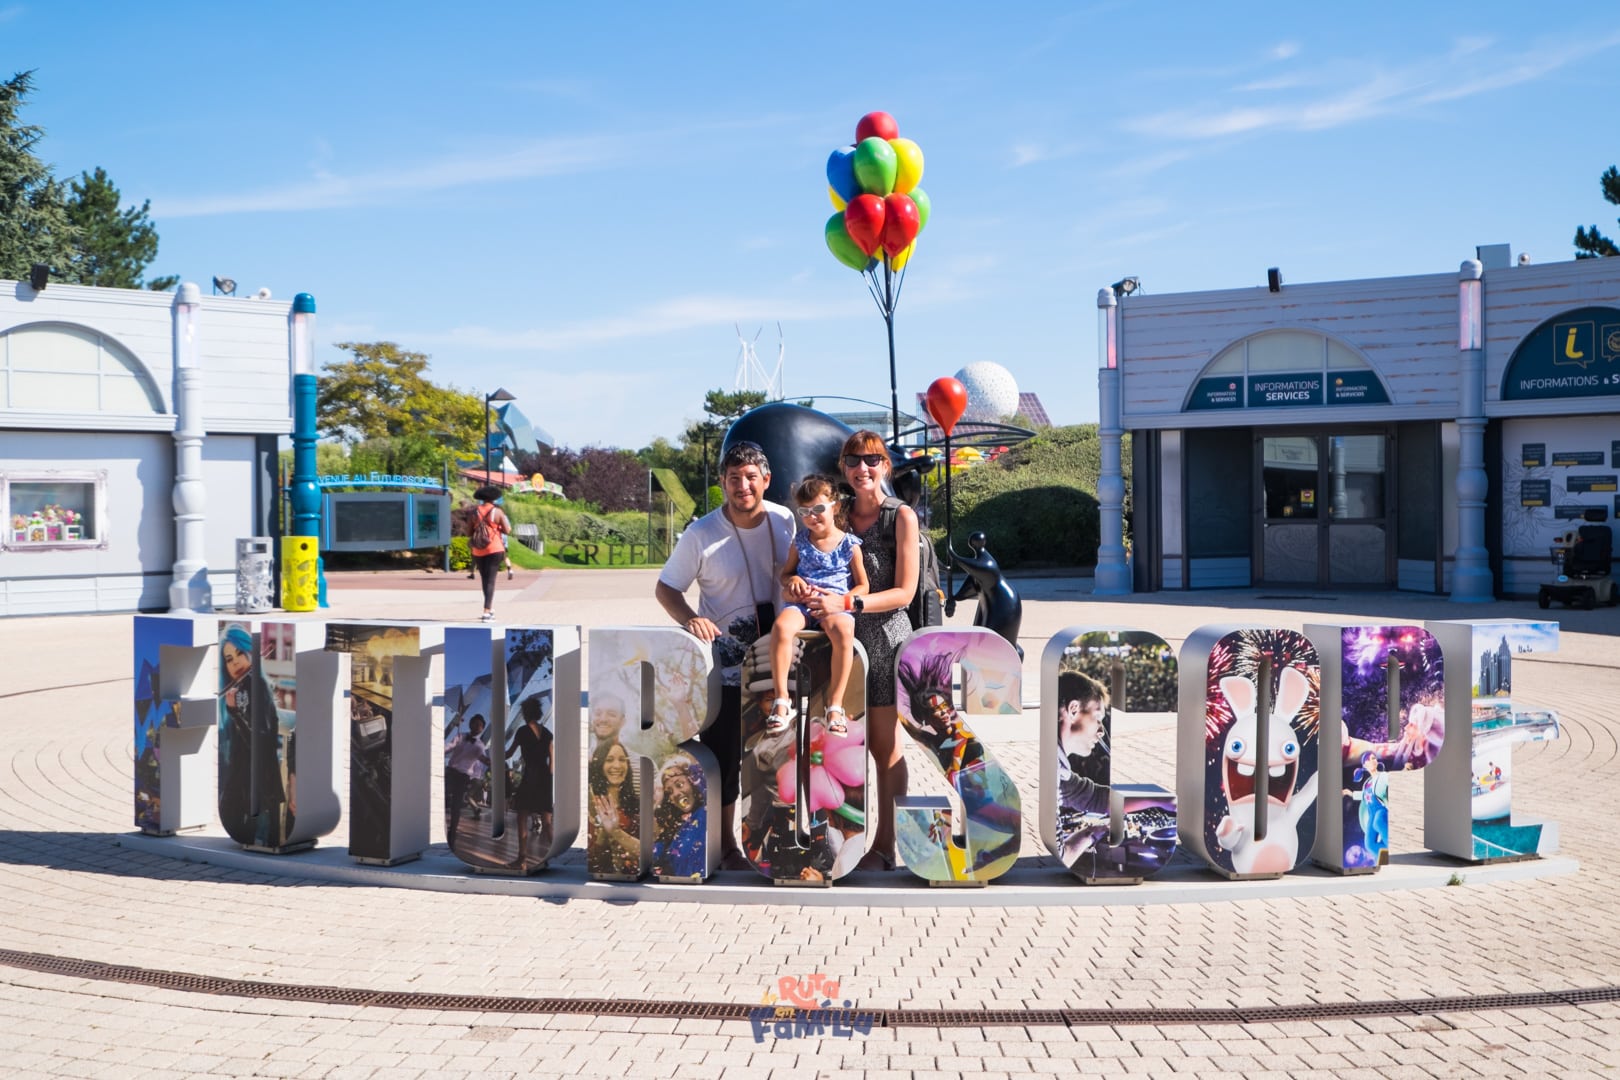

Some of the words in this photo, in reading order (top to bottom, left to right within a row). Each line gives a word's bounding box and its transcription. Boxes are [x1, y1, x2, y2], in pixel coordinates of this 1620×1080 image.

[1254, 380, 1320, 392] INFORMATIONS
[1520, 375, 1599, 390] INFORMATIONS
[1611, 373, 1620, 384] S
[1266, 391, 1310, 401] SERVICES
[318, 474, 350, 483] VENUE
[353, 473, 366, 482] AU
[369, 471, 440, 485] FUTUROSCOPE
[558, 542, 672, 566] GREEN
[134, 616, 1559, 882] FUTUROSCOPE
